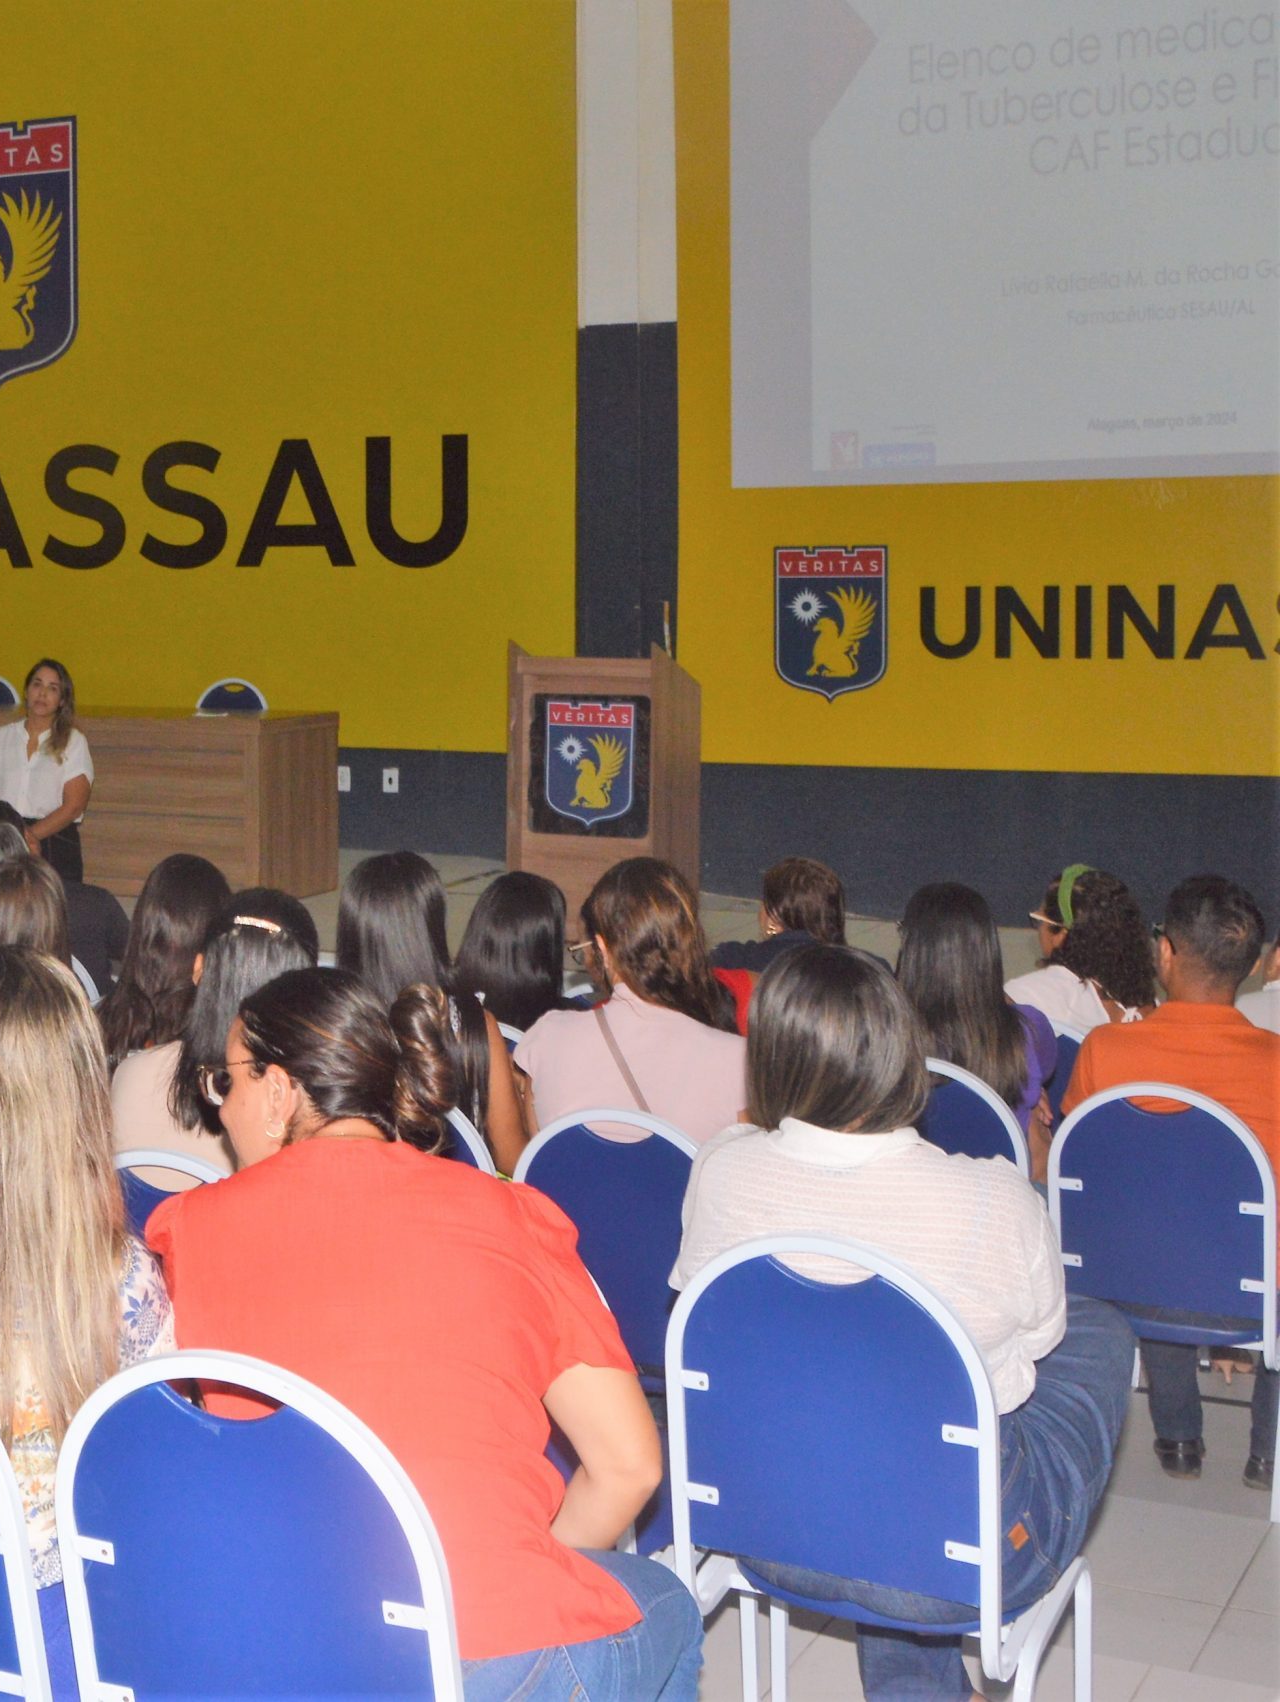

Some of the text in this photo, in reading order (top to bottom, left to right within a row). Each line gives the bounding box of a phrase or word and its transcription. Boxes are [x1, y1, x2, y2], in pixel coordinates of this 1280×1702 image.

[909, 9, 1274, 85] Elenco de medica
[898, 99, 949, 137] da
[961, 72, 1197, 131] Tuberculose
[1213, 72, 1237, 103] e
[1029, 128, 1111, 176] CAF
[1154, 266, 1181, 287] da
[1186, 261, 1250, 285] Rocha
[782, 561, 879, 573] VERITAS
[919, 583, 1280, 660] UNINA
[552, 712, 629, 724] VERITAS
